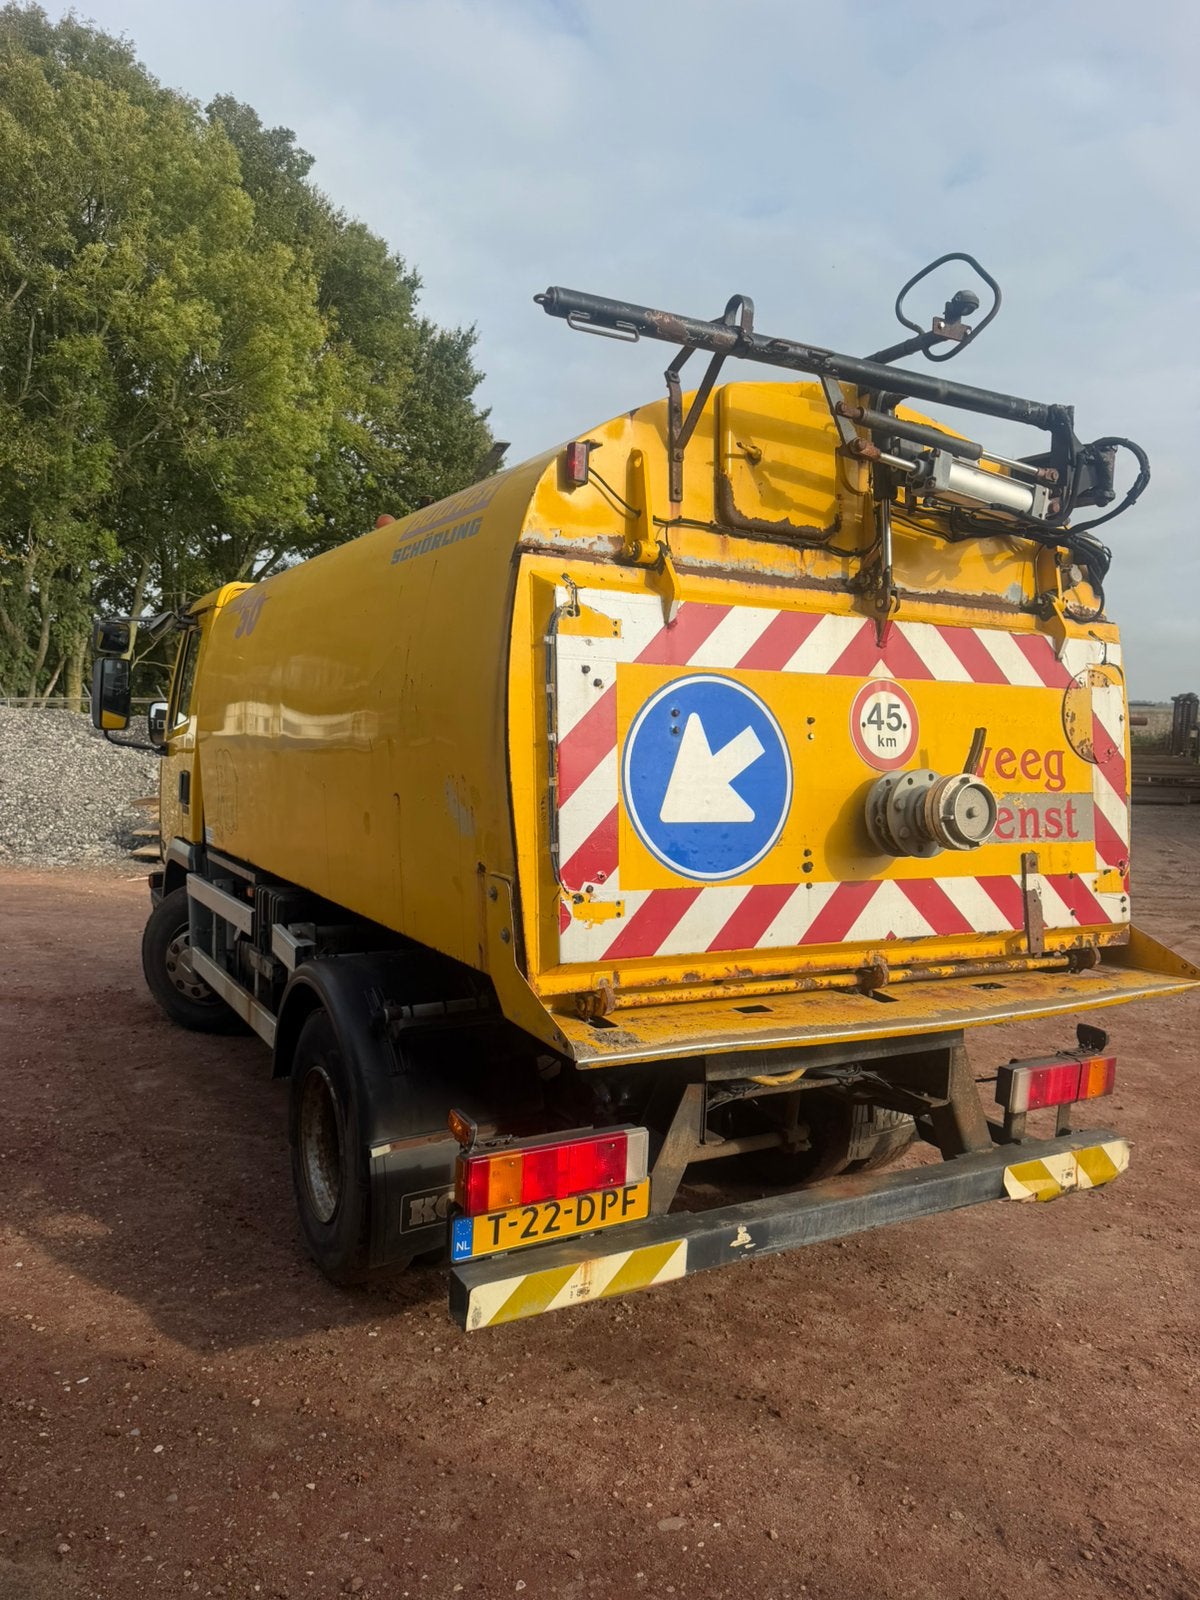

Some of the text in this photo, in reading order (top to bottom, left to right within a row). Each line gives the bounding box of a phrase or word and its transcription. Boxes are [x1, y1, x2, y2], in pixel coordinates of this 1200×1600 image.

[391, 516, 483, 564] SCHÖRLING
[866, 702, 903, 732] 45
[877, 734, 897, 748] km
[994, 798, 1079, 839] enst
[487, 1185, 638, 1246] T-22-DPF
[456, 1240, 471, 1252] NL
